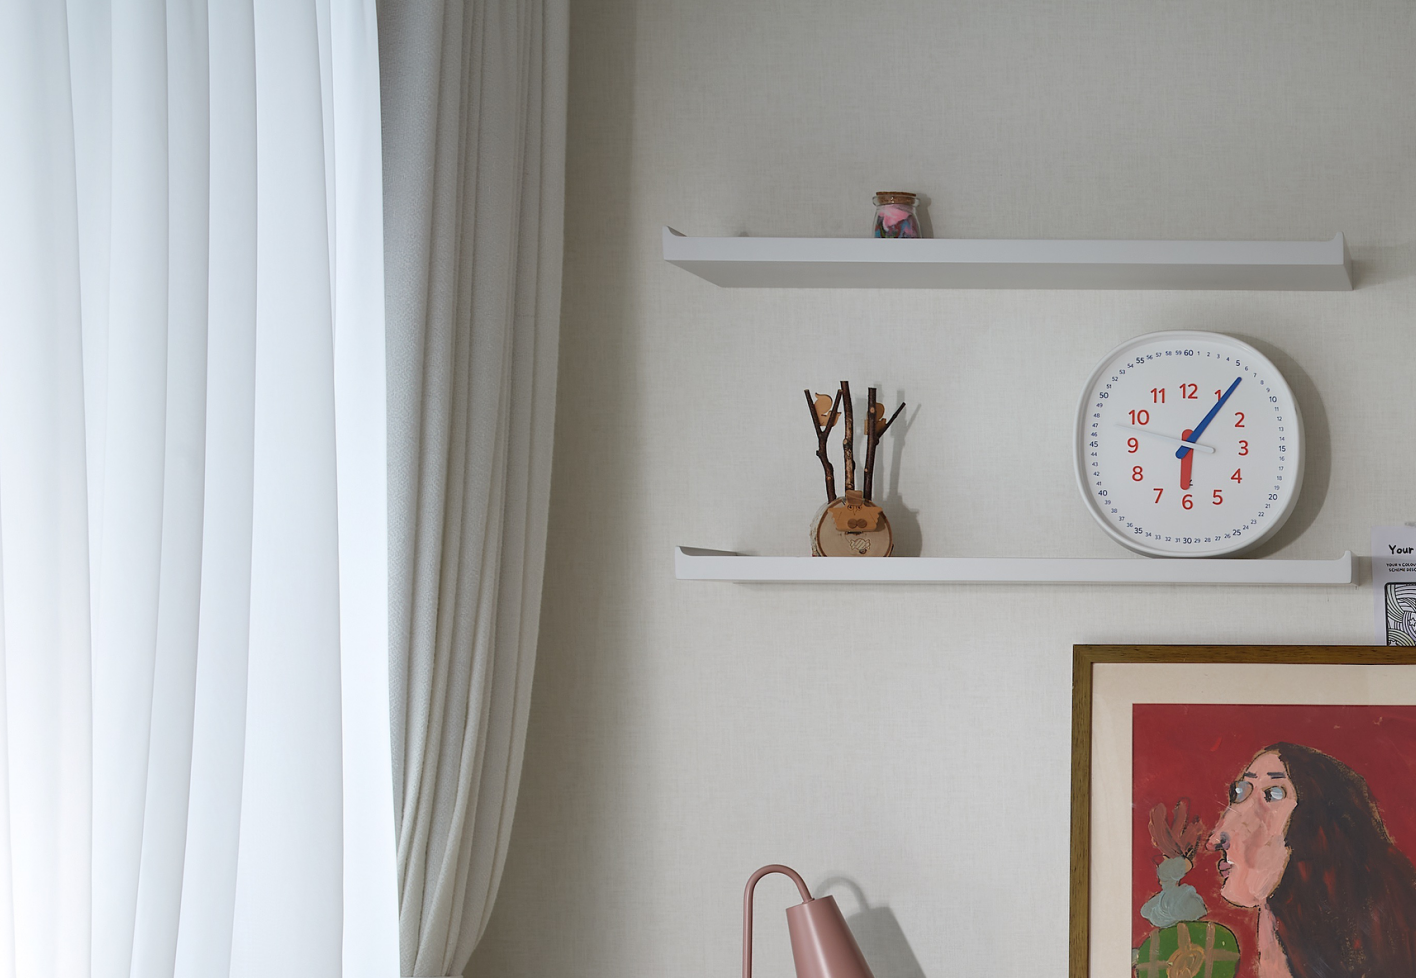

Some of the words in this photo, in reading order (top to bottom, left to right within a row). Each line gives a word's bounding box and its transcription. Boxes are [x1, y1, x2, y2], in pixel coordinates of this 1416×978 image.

[1150, 388, 1165, 403] 11
[1179, 383, 1198, 399] 12
[1128, 409, 1150, 425] 10
[1234, 412, 1245, 428] 2
[1127, 437, 1138, 453] 9
[1238, 440, 1249, 456] 3
[1132, 466, 1144, 482] 8
[1231, 468, 1242, 484] 4
[1153, 488, 1164, 504] 7
[1182, 494, 1194, 510] 6
[1212, 489, 1223, 505] 5
[1388, 544, 1415, 555] Your
